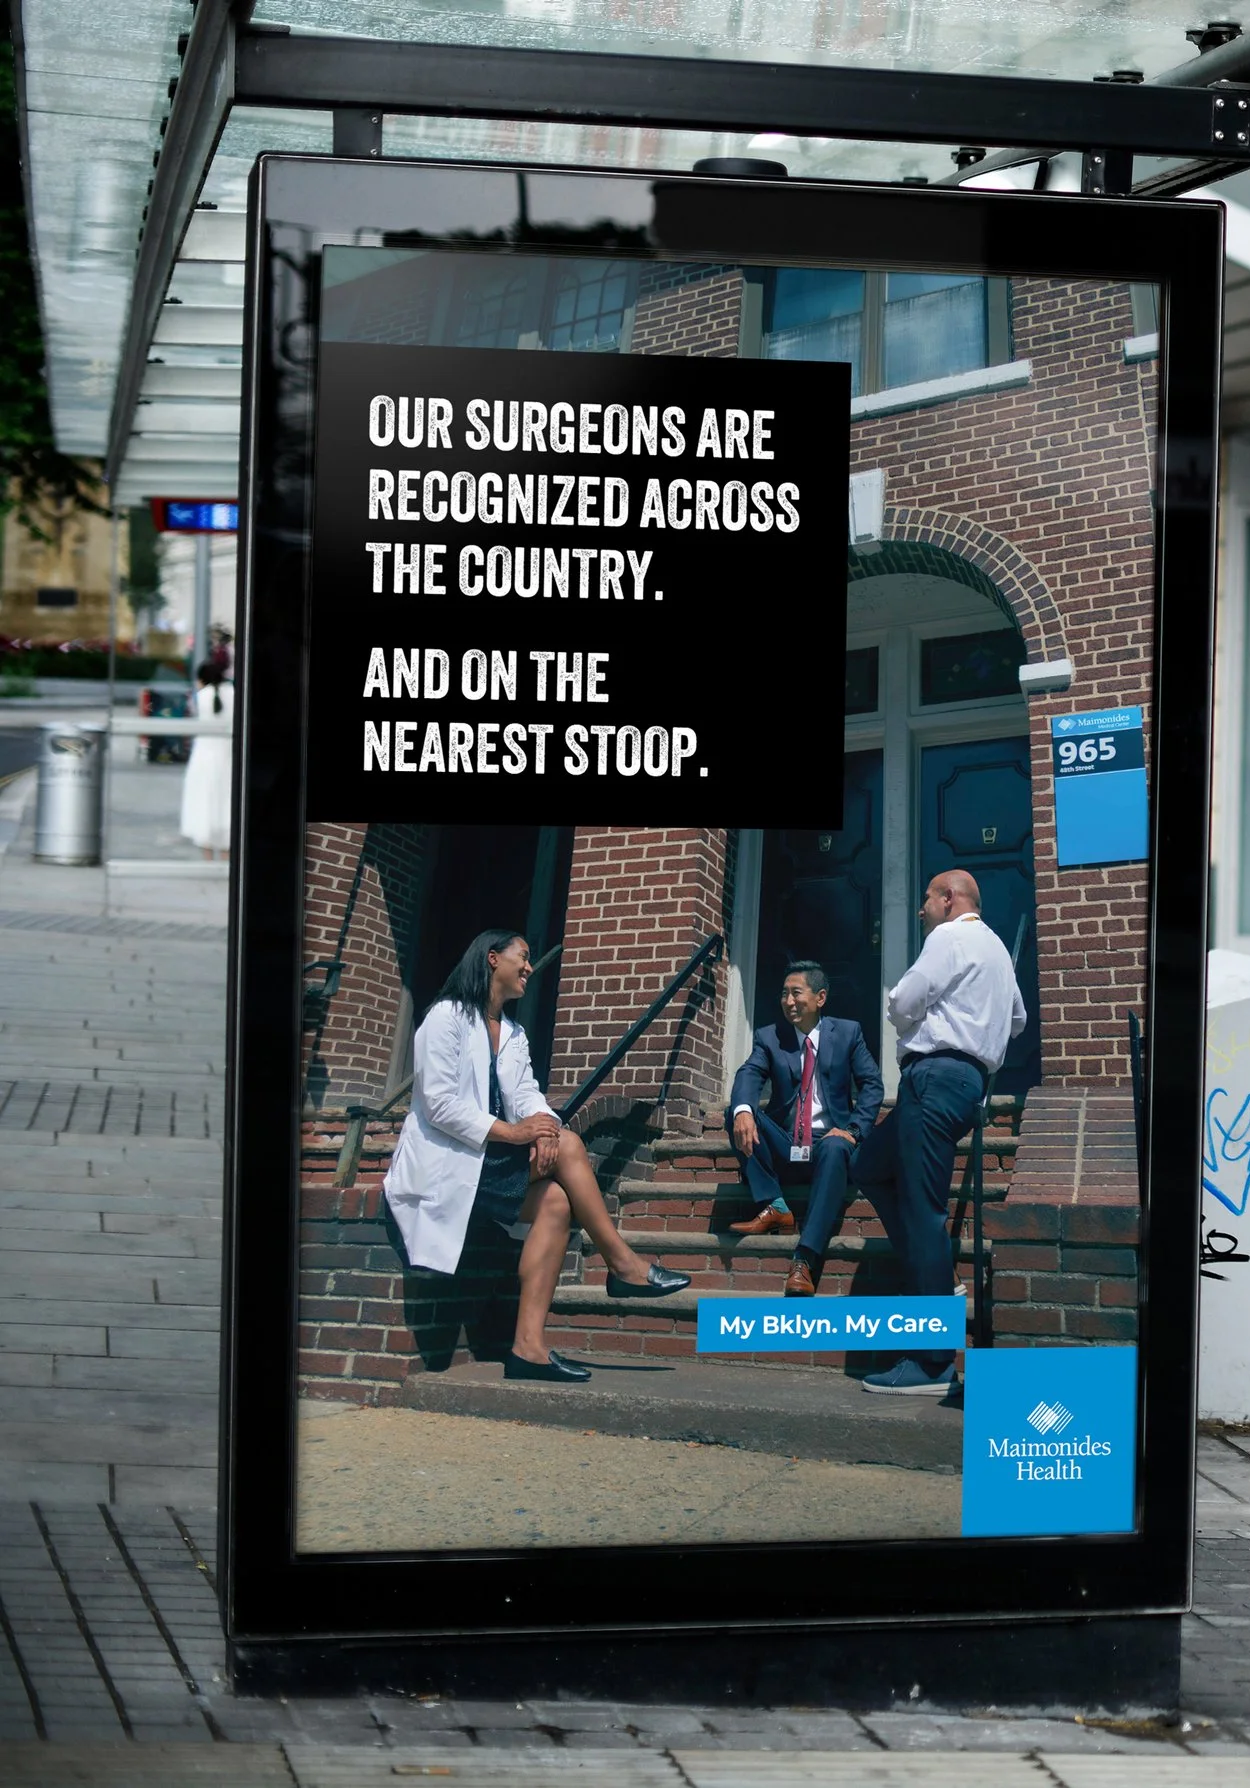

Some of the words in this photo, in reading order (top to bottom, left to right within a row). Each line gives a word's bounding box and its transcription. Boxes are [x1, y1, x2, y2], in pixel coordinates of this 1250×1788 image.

[369, 395, 453, 449] OUR
[466, 399, 686, 457] SURGEONS
[696, 408, 775, 460] ARE
[369, 469, 629, 528] RECOGNIZED
[640, 478, 800, 533] ACROSS
[366, 543, 446, 595] THE
[459, 545, 663, 600] COUNTRY.
[363, 648, 450, 699] AND
[462, 649, 517, 700] ON
[530, 651, 610, 703] THE
[1077, 713, 1130, 727] Maimonides
[364, 721, 554, 775] NEAREST
[564, 725, 709, 777] STOOP.
[1058, 736, 1117, 766] 965
[719, 1315, 756, 1340] My
[763, 1314, 838, 1340] Bklyn.
[845, 1315, 881, 1338] My
[888, 1313, 948, 1334] Care.
[988, 1435, 1112, 1458] Maimonides
[1016, 1459, 1082, 1481] Health
